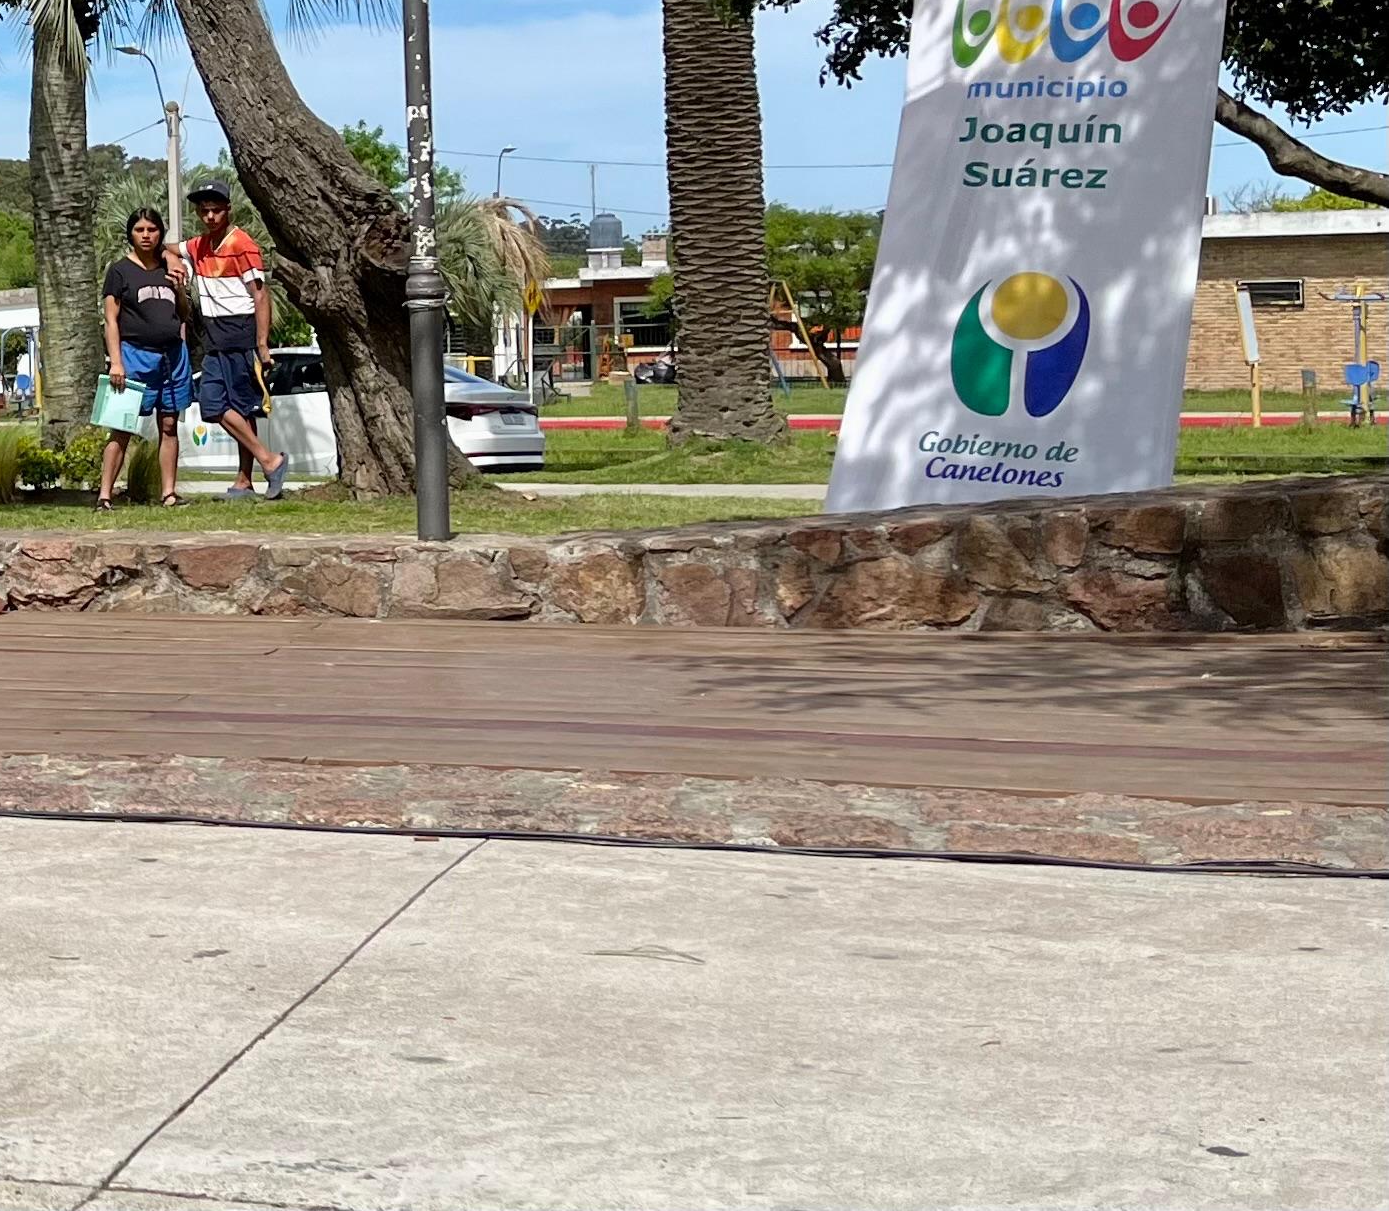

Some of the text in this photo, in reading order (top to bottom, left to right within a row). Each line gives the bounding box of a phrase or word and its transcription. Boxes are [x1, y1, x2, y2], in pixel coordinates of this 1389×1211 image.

[967, 75, 1128, 103] municipio
[959, 114, 1122, 149] Joaquín
[962, 158, 1108, 189] Suárez
[918, 431, 1079, 463] Gobierno de
[925, 456, 1064, 487] Canelones
